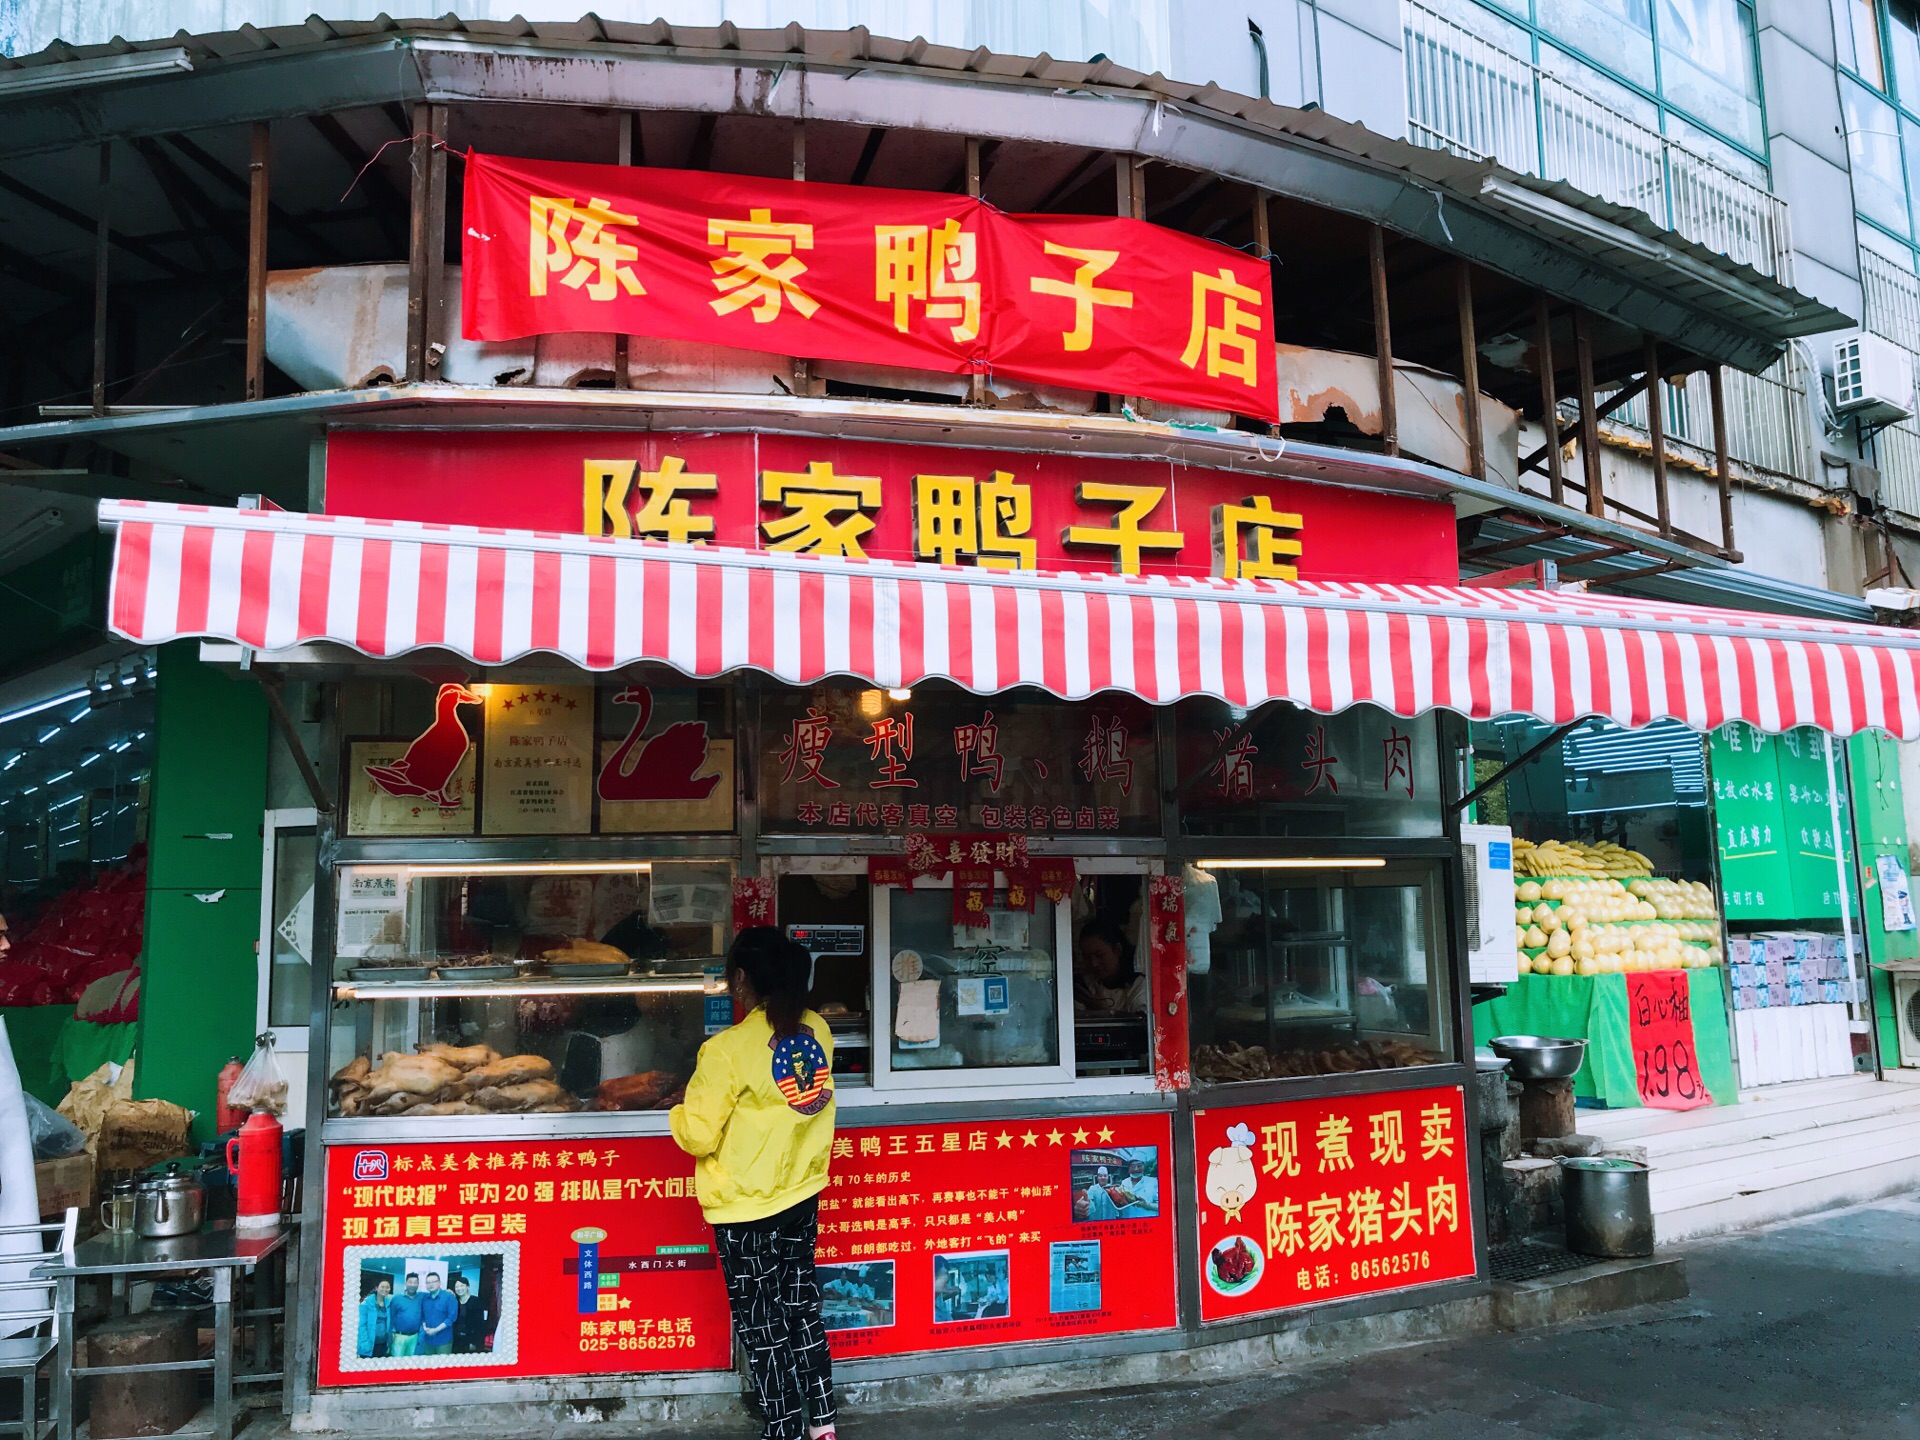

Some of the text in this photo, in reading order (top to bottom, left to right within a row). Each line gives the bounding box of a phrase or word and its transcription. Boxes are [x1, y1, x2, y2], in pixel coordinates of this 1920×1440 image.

[529, 195, 1262, 388] 陈家鸭子店
[582, 456, 1304, 580] 陈家鸭子店
[798, 800, 1120, 830] 本店代客真空 包装各色卤菜
[749, 899, 768, 920] 祥
[1635, 977, 1689, 1027] 白心柚
[1643, 1040, 1696, 1101] 1.98
[832, 1130, 988, 1158] 美鸭王五星店
[1261, 1103, 1454, 1179] 现煮现卖
[392, 1149, 621, 1172] 标点美食推荐陈家鸭子
[342, 1213, 527, 1240] 现场真空包装
[1265, 1175, 1459, 1259] 陈家猪头肉
[583, 1249, 593, 1289] 文体西路
[628, 1259, 687, 1270] 水西门大街
[580, 1318, 693, 1336] 陈家鸭子电话
[579, 1335, 697, 1352] 025-86562576
